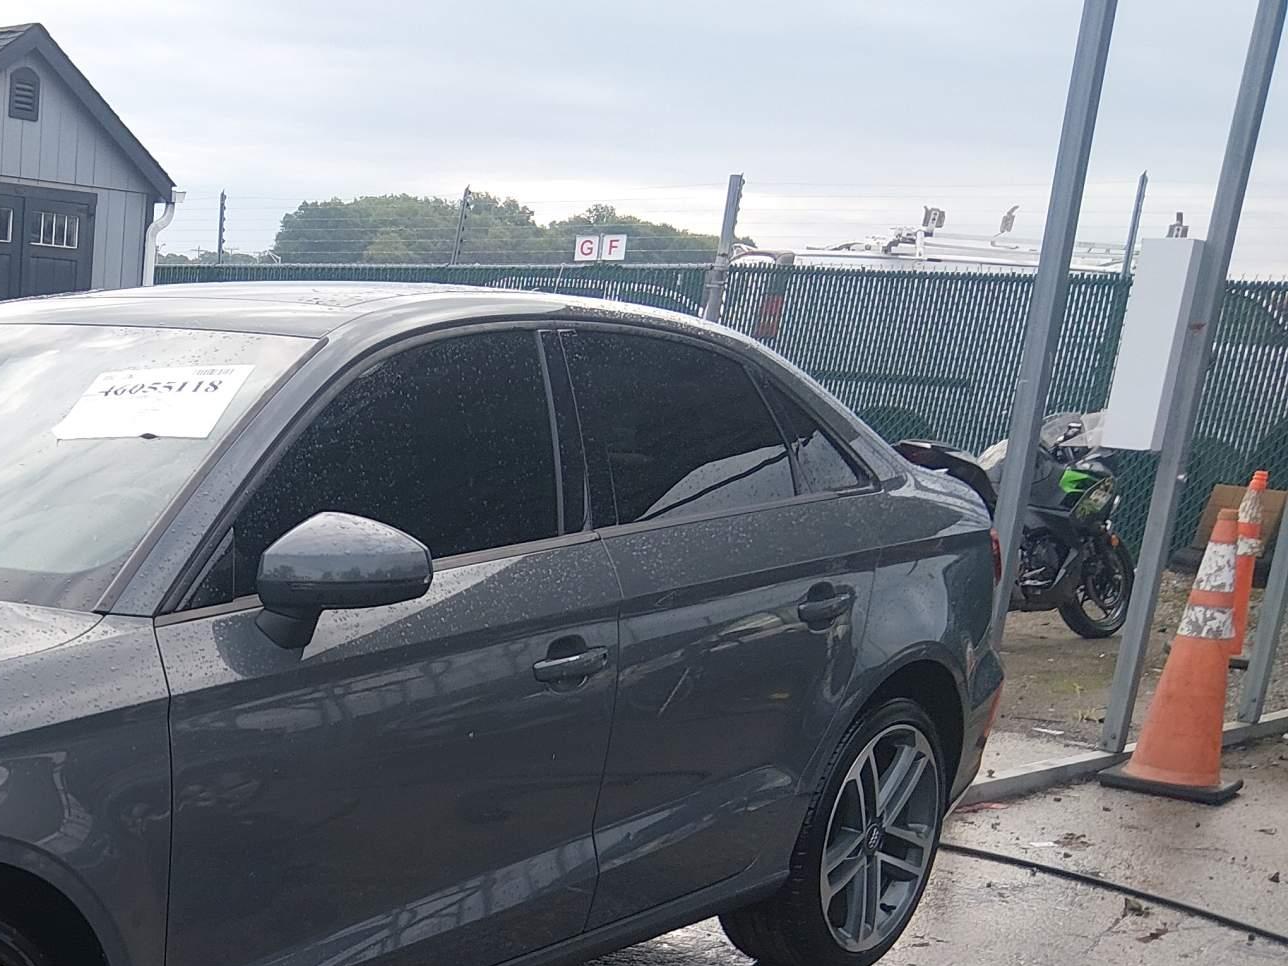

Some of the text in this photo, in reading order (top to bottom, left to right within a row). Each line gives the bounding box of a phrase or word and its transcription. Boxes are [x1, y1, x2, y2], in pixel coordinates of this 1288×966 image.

[580, 239, 594, 256] G
[608, 239, 620, 256] F
[98, 379, 224, 397] 46055118
